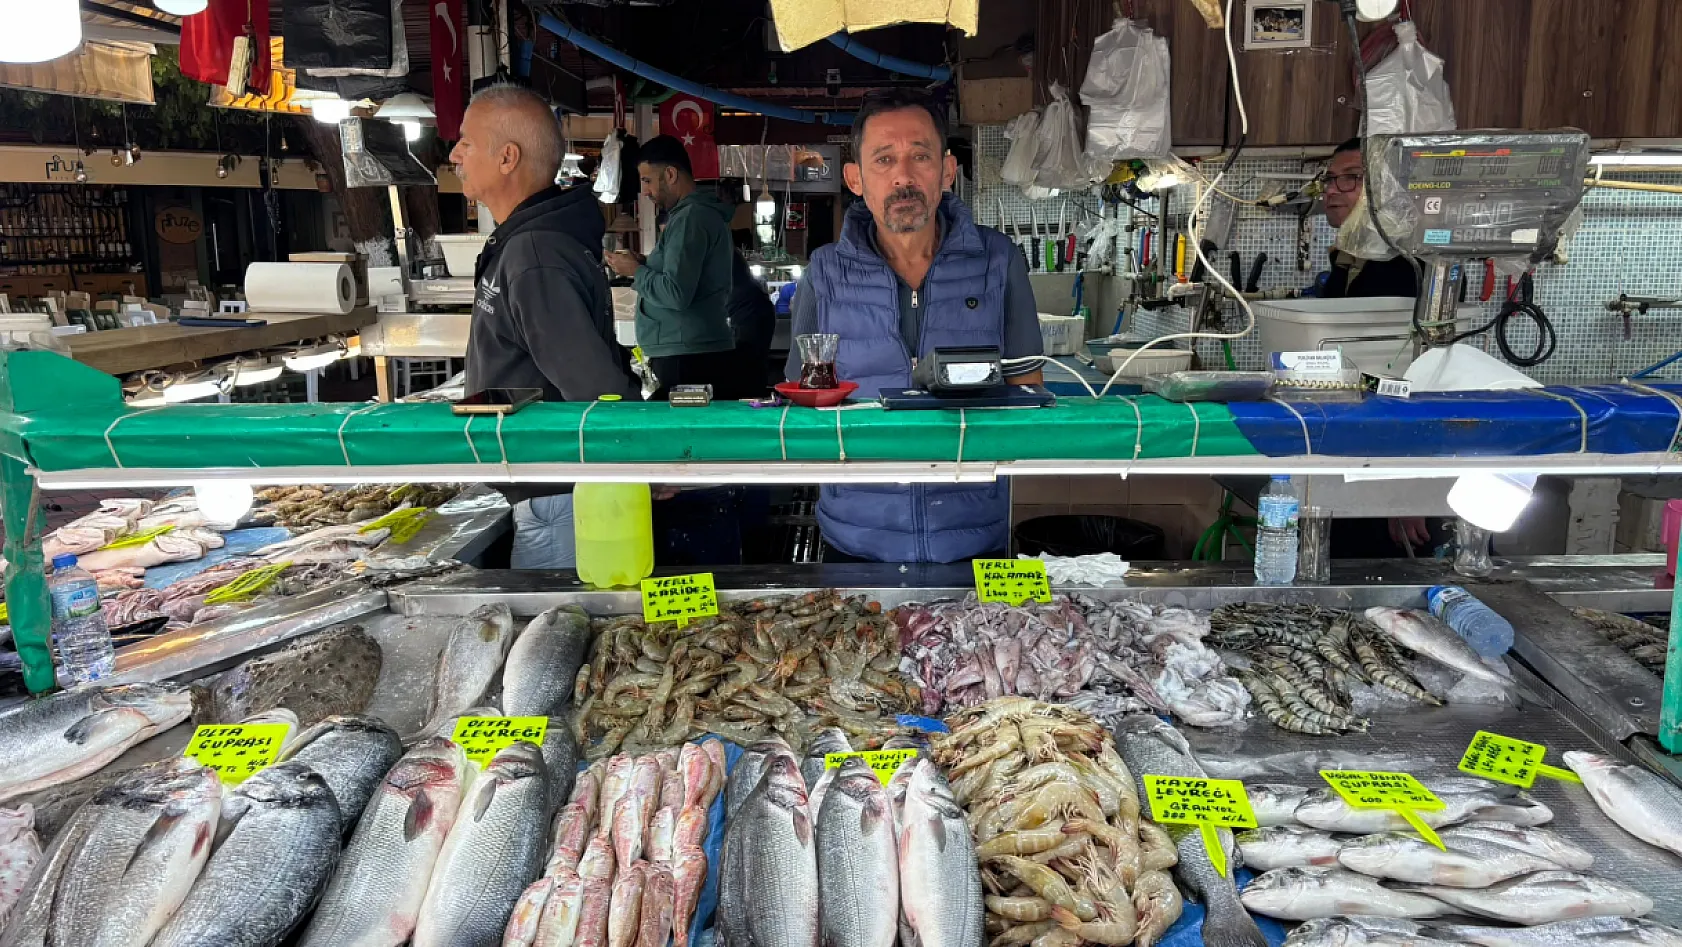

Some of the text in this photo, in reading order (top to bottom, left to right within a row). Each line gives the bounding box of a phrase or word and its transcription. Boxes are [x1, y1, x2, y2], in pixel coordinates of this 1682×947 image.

[1453, 229, 1502, 242] SCALE
[198, 728, 243, 737] OLTA
[1156, 779, 1208, 788] KAYA
